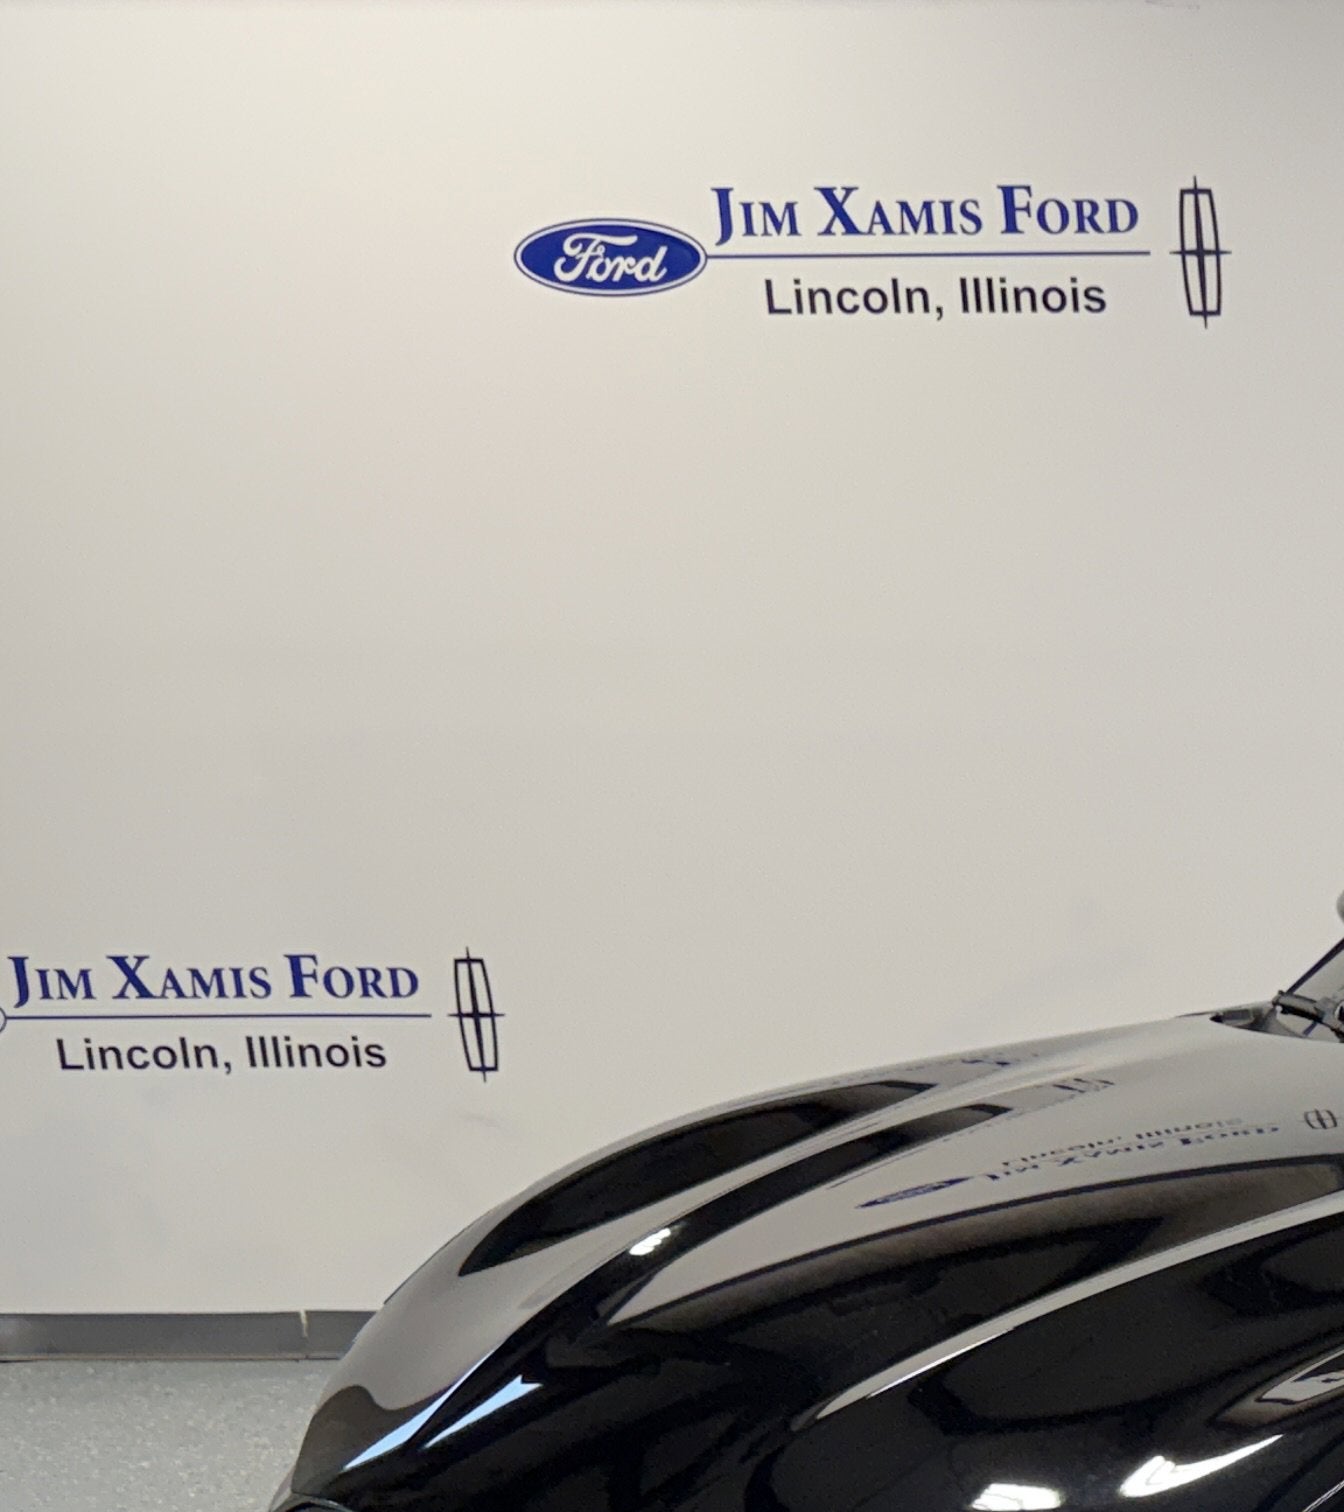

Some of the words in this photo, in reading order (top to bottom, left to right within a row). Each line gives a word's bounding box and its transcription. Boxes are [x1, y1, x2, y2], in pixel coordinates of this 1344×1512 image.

[711, 186, 801, 246] JIM
[813, 186, 983, 237] XAMIS
[997, 184, 1139, 235] FORD
[553, 232, 668, 283] Ford
[764, 277, 944, 322] Lincoln,
[959, 276, 1107, 314] Illinois
[7, 955, 97, 1009] JIM
[106, 954, 272, 1000] XAMIS
[283, 953, 419, 999] FORD
[55, 1036, 232, 1076] Lincoln,
[245, 1035, 387, 1069] Illinois
